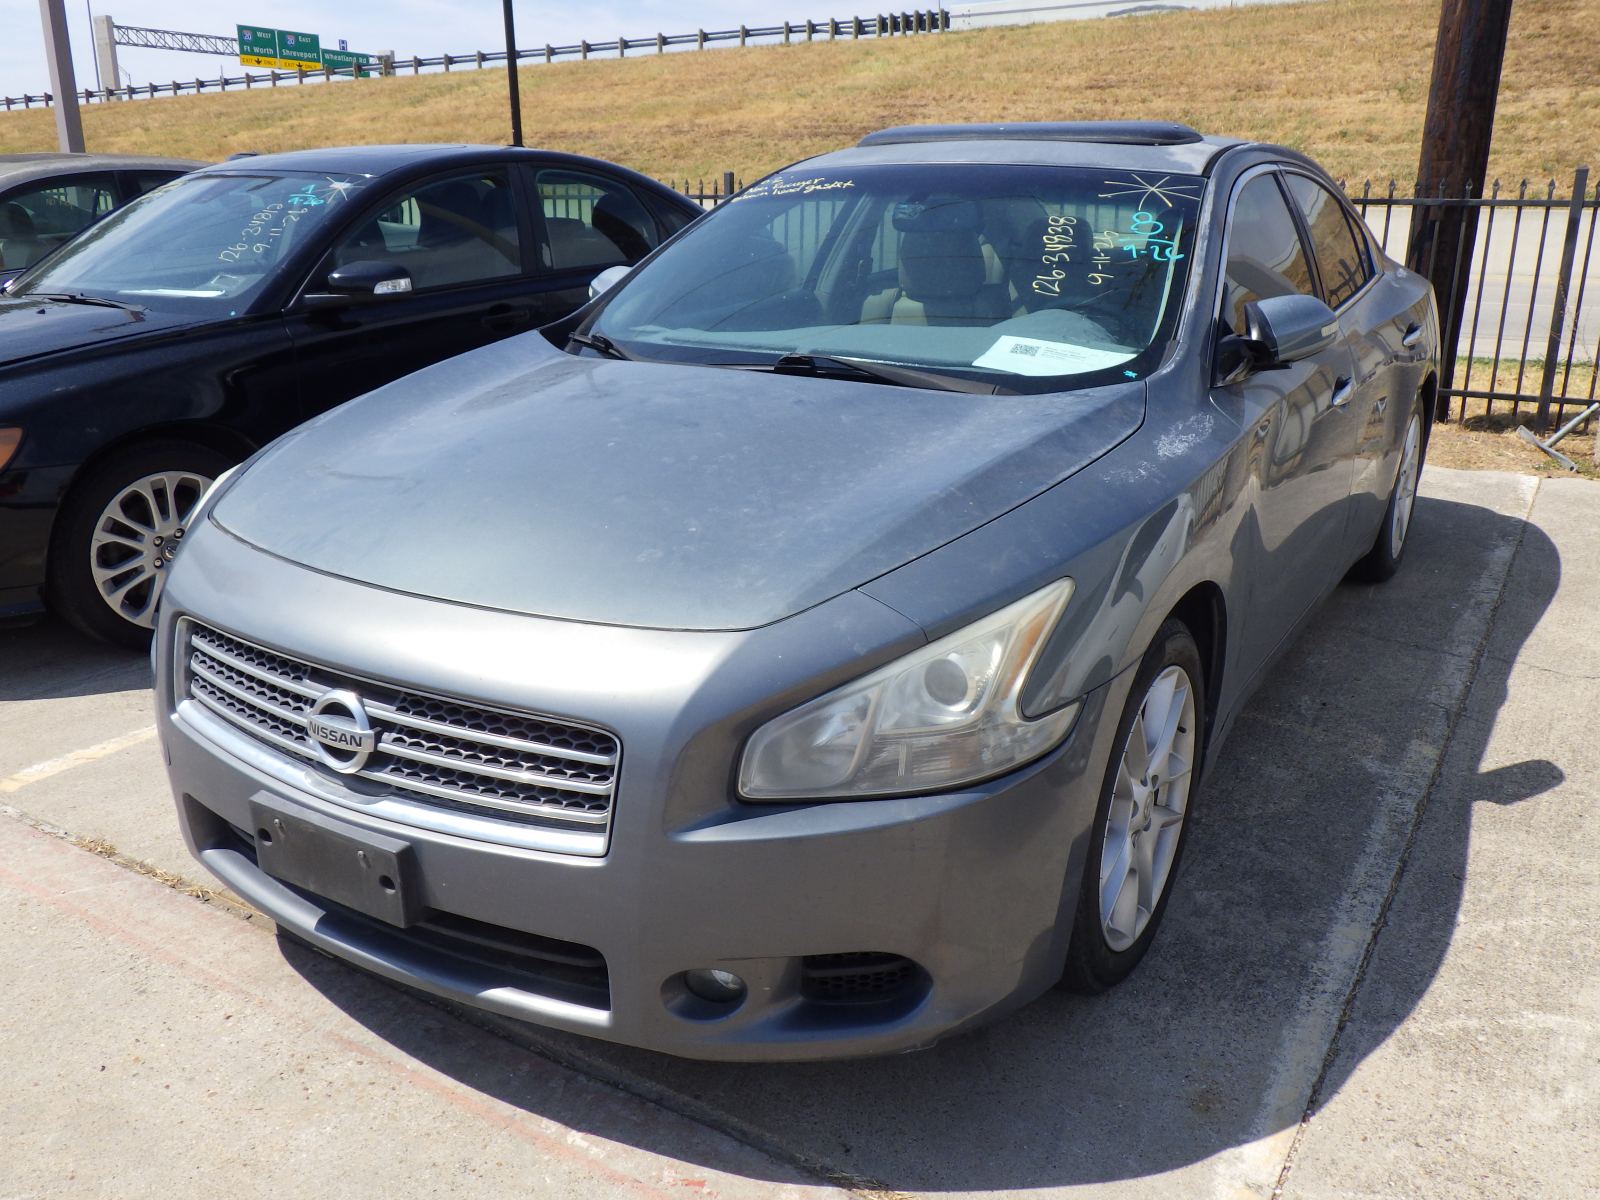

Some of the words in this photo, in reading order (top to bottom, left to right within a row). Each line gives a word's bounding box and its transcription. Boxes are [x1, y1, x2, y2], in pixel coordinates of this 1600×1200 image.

[243, 45, 250, 53] Ft
[253, 46, 274, 55] Worth
[339, 39, 347, 51] H
[282, 49, 317, 59] Shreveport
[324, 53, 357, 63] Wheatland
[308, 720, 362, 748] NISSAN
